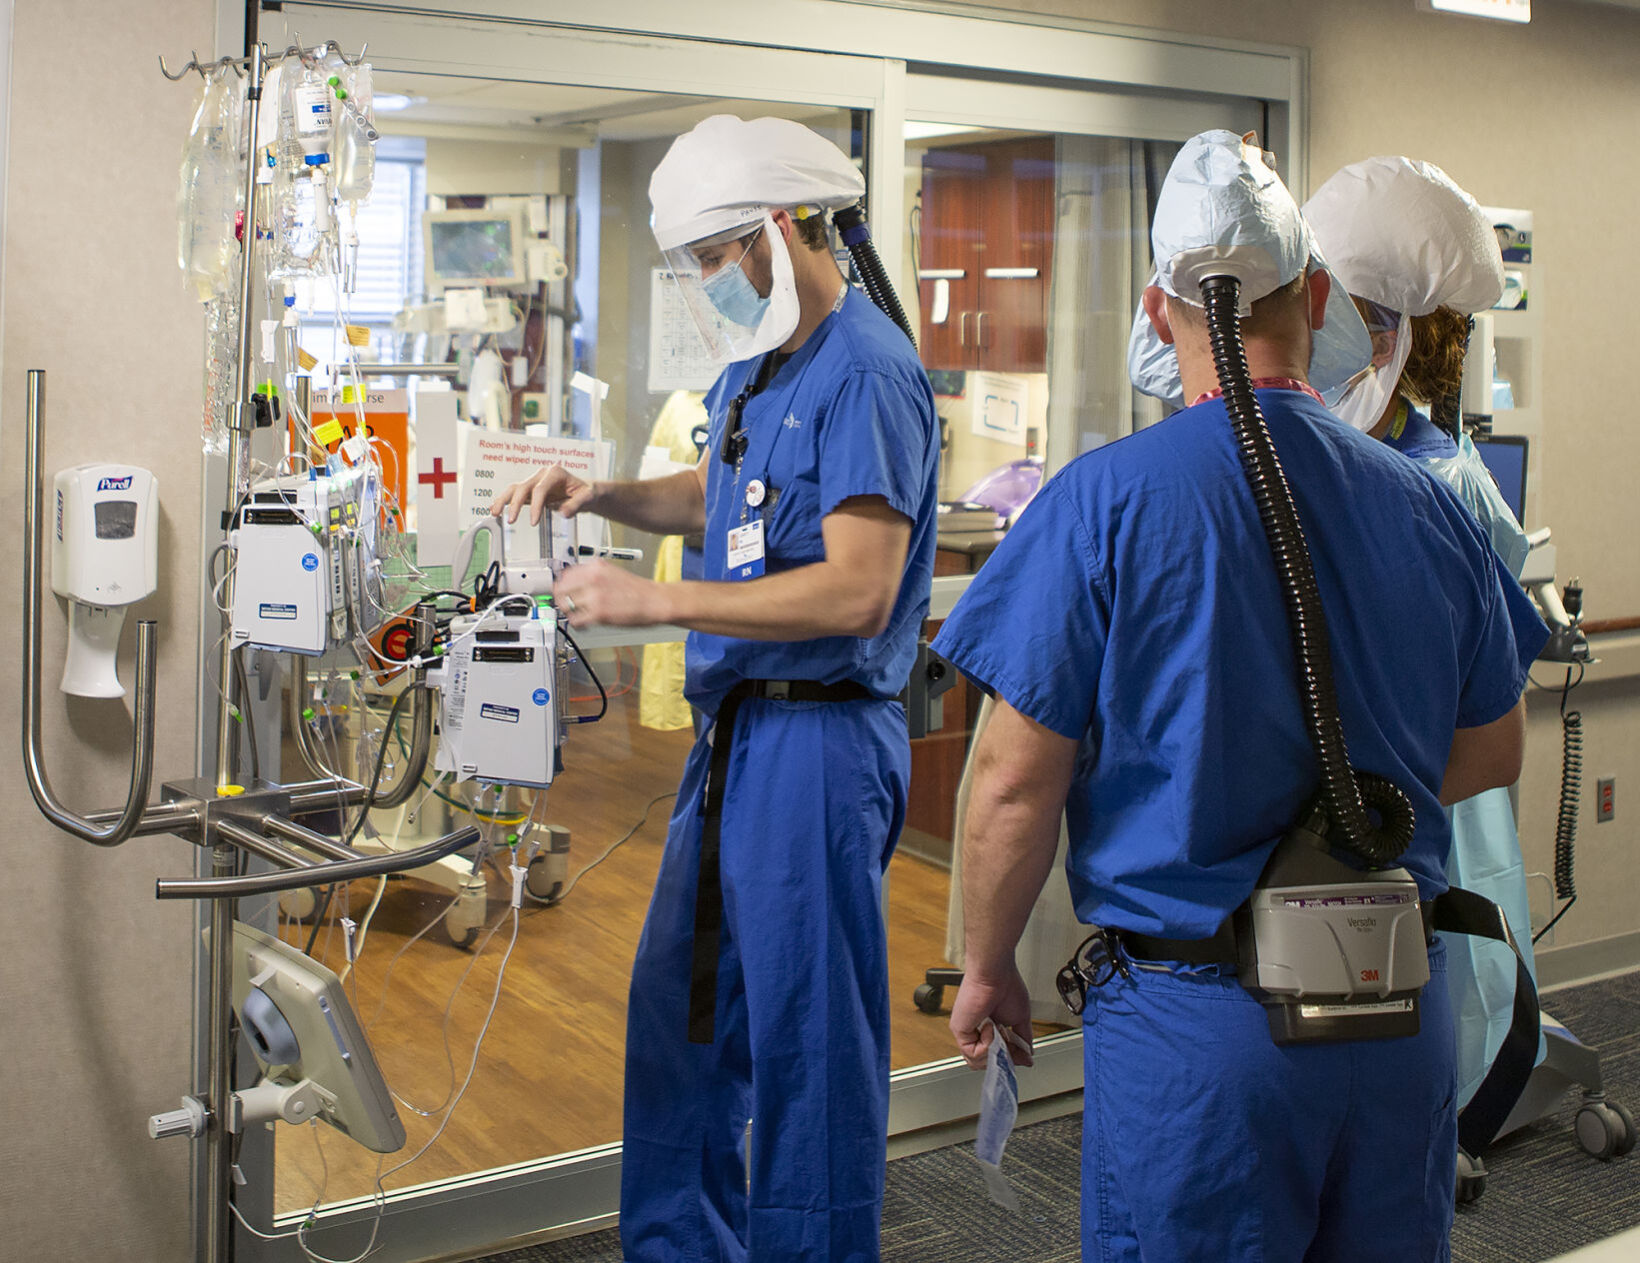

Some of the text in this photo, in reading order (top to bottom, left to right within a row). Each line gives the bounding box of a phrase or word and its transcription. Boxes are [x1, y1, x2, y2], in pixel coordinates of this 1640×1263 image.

[479, 439, 595, 458] Room's high touch surfaces
[482, 453, 503, 462] need
[505, 455, 530, 465] wiped
[564, 460, 588, 469] hours
[475, 469, 494, 479] 0800
[473, 488, 492, 497] 1200
[471, 507, 490, 516] 1600
[1360, 969, 1379, 982] 3M
